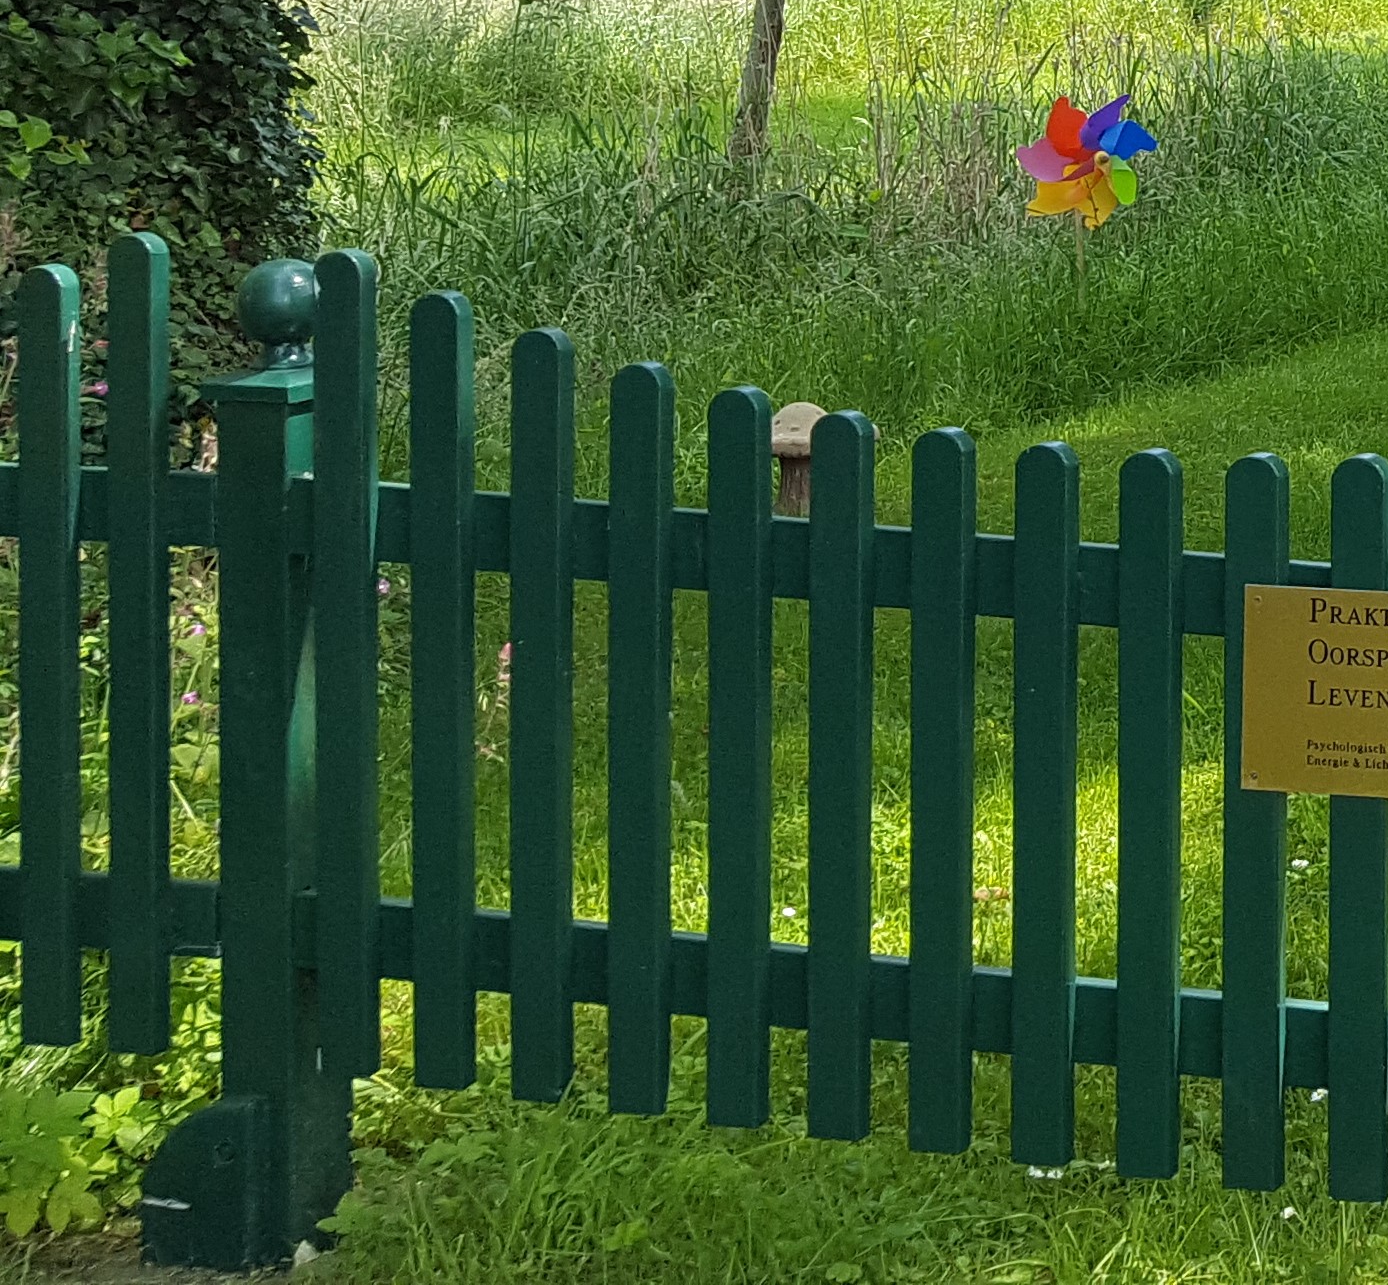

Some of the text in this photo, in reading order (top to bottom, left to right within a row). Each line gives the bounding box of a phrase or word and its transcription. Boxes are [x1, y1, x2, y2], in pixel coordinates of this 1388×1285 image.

[1307, 740, 1386, 755] Psychologisch
[1307, 756, 1349, 769] Energie
[1352, 759, 1360, 768] &
